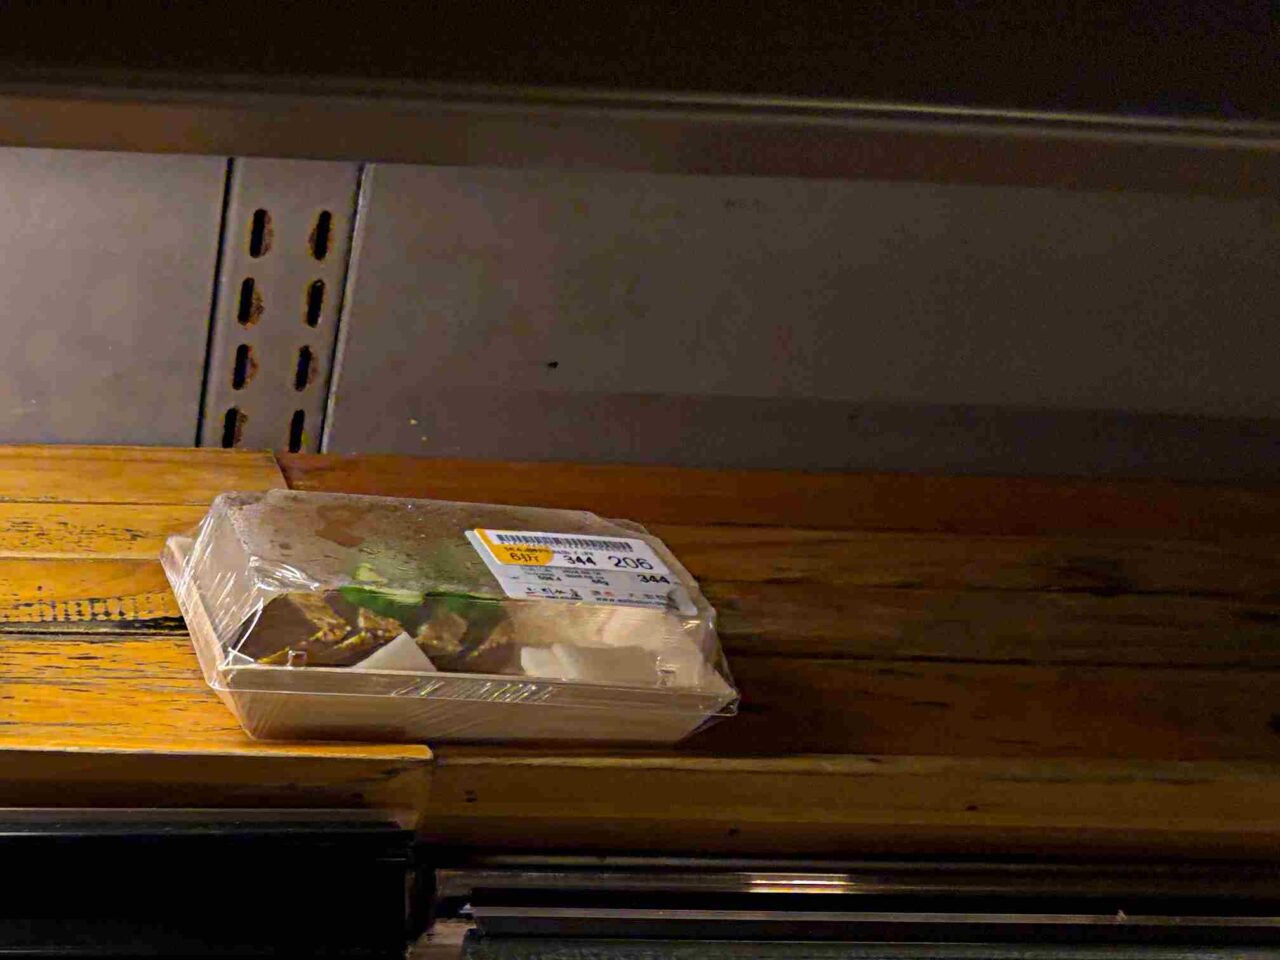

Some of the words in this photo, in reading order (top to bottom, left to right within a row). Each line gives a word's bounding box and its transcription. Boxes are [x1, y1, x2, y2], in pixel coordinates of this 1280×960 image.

[563, 555, 597, 566] 344
[608, 555, 654, 570] 206
[636, 574, 670, 584] 344
